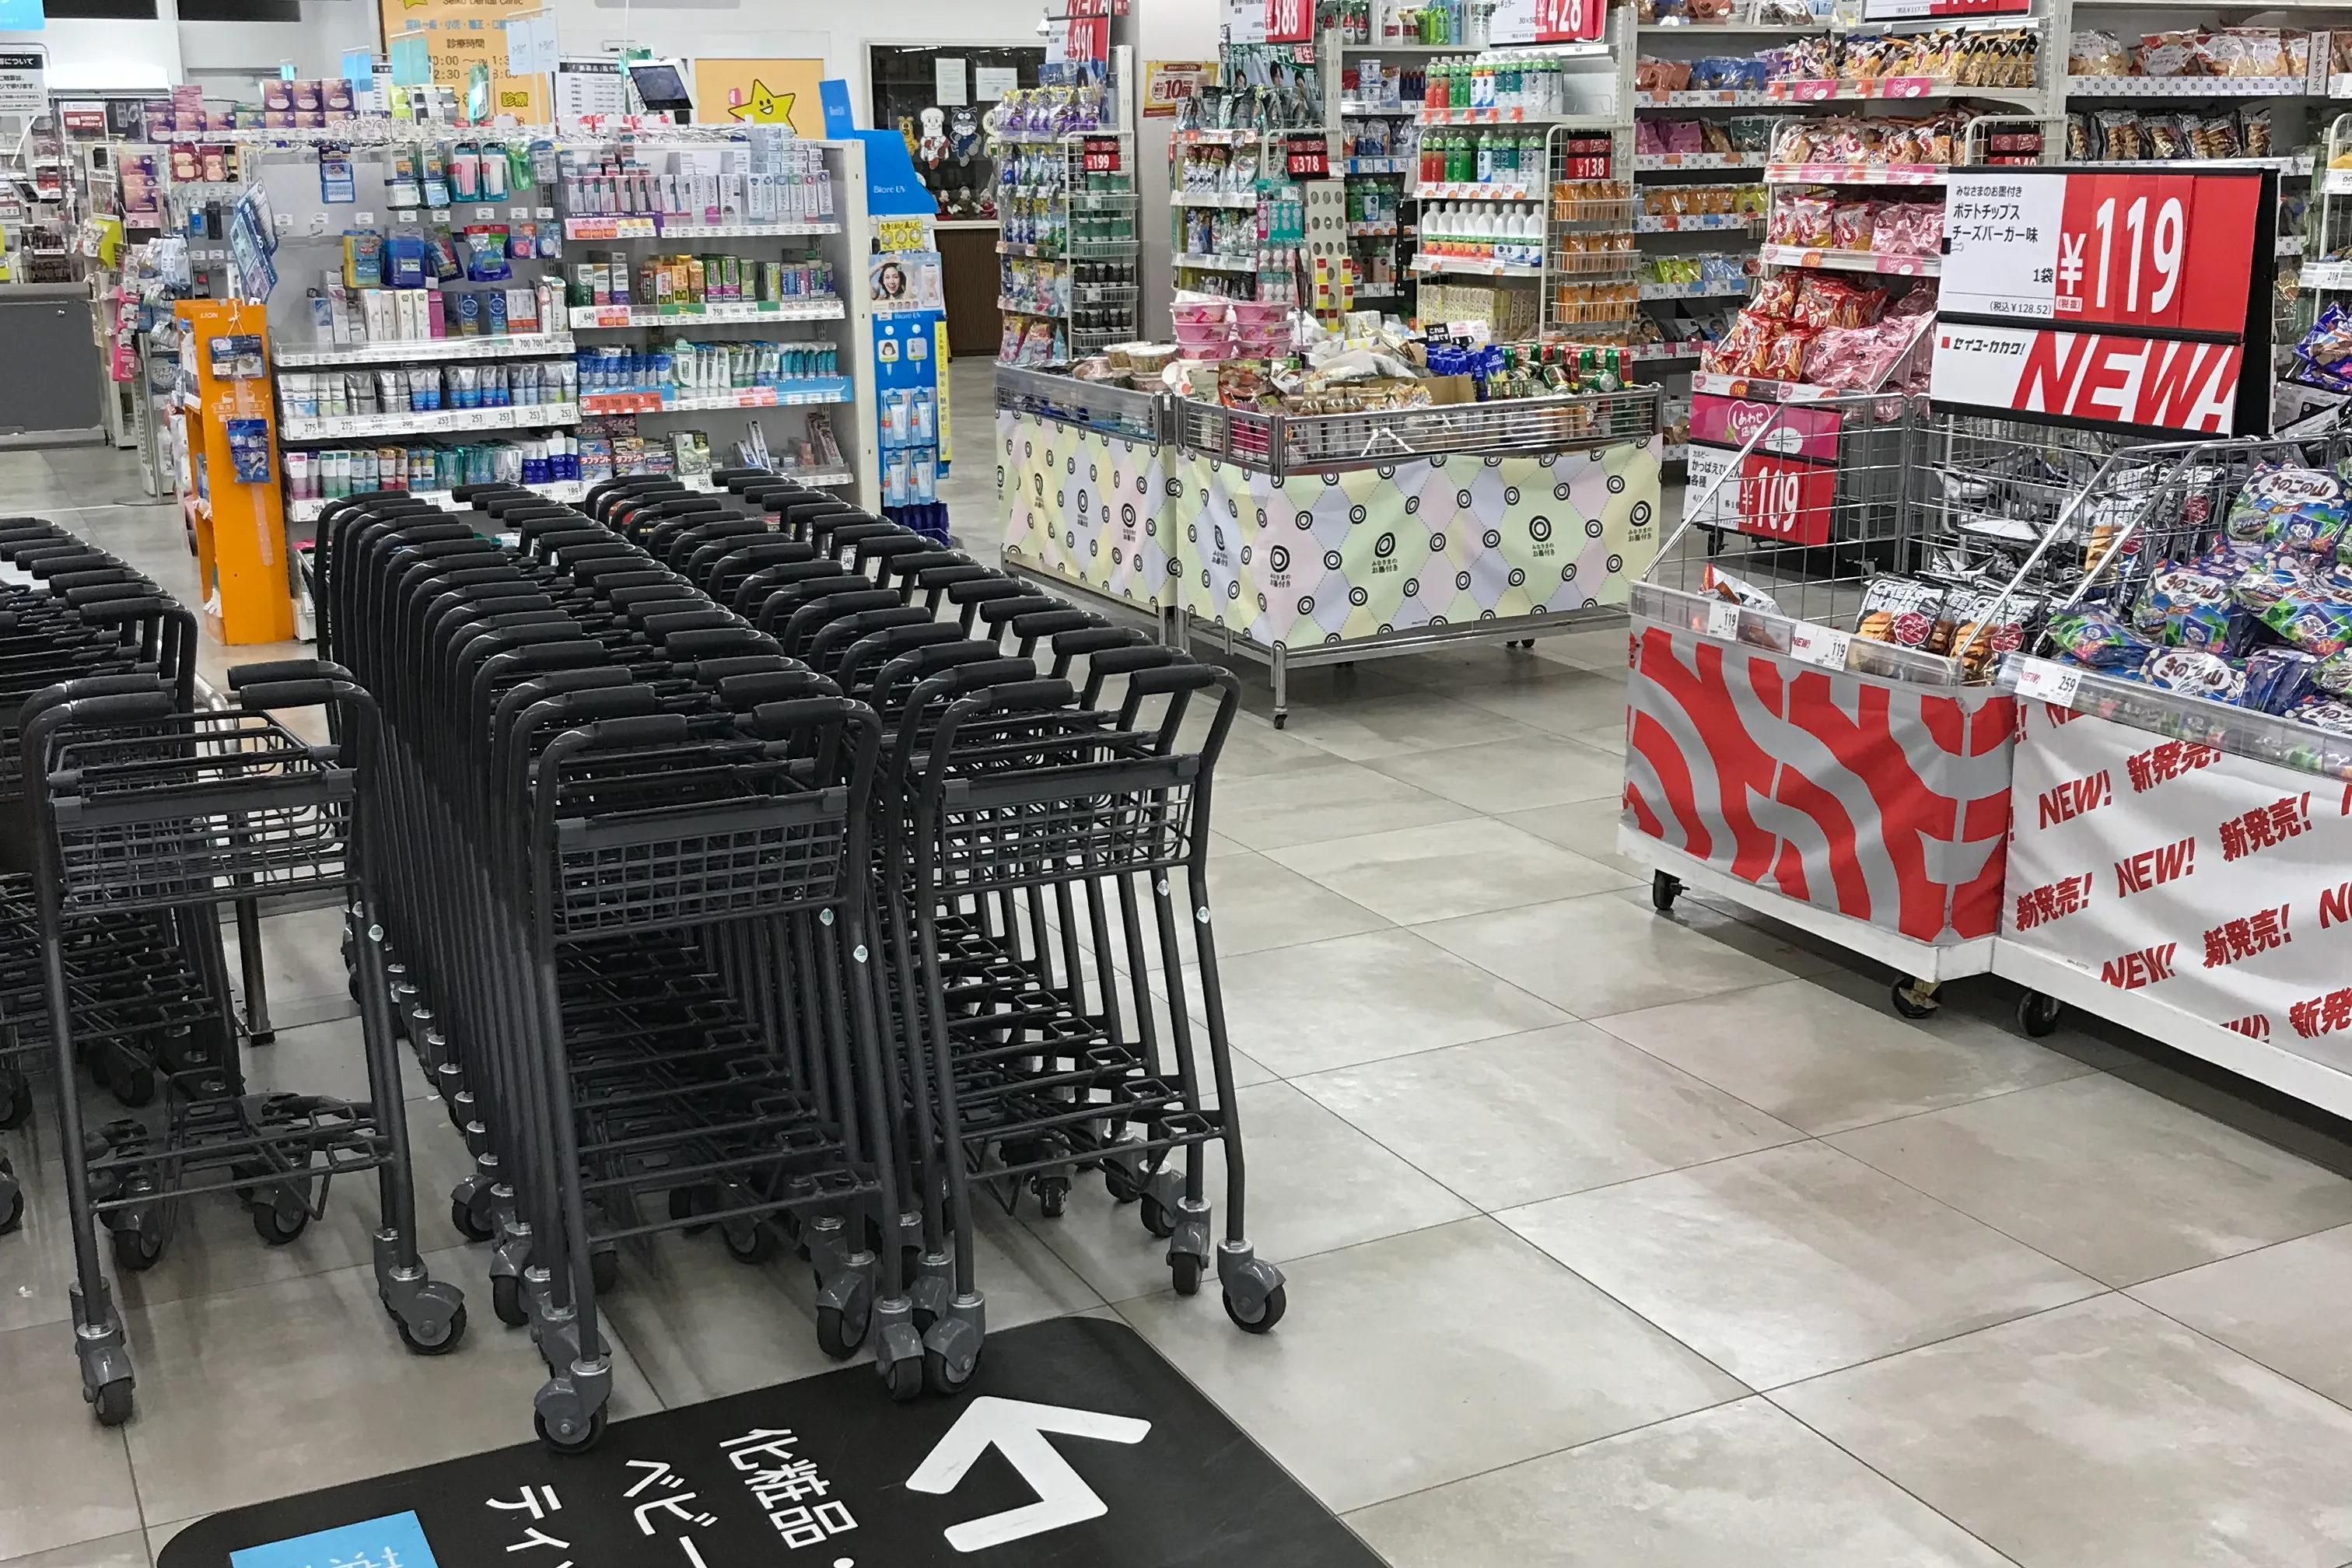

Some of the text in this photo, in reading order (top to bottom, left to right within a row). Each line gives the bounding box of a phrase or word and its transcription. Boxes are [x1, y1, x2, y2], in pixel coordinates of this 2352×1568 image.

[446, 39, 485, 49] 診療時間
[2312, 34, 2326, 92] ポテトチップス
[1956, 186, 2022, 198] みなさまのお墨付き
[1953, 203, 2021, 220] ポテトチップス
[1952, 225, 2039, 243] チーズバーガー味
[2033, 268, 2053, 283] 1袋
[438, 416, 449, 425] 253
[471, 414, 483, 422] 253
[499, 412, 510, 421] 253
[530, 411, 541, 420] 253
[1732, 410, 1765, 430] しあわせ
[304, 424, 317, 432] 275
[341, 422, 353, 430] 275
[580, 456, 611, 464] タフデント
[614, 453, 644, 463] タフデント
[1691, 475, 1706, 488] 各種
[2266, 474, 2331, 497] きのこの山
[1627, 527, 1652, 535] みなさまの
[2161, 574, 2221, 600] きのこの山
[1724, 612, 1737, 627] 119
[1832, 642, 1846, 657] 119
[2058, 675, 2077, 692] 259
[2038, 769, 2112, 830] NEW!
[2218, 791, 2312, 862] 新発売!
[2114, 836, 2196, 898] NEW!
[2016, 872, 2093, 932] 新発売!
[2319, 881, 2352, 929] N
[2203, 903, 2292, 968] 新発売!
[2100, 942, 2176, 990] NEW!
[485, 1484, 576, 1568] ティ
